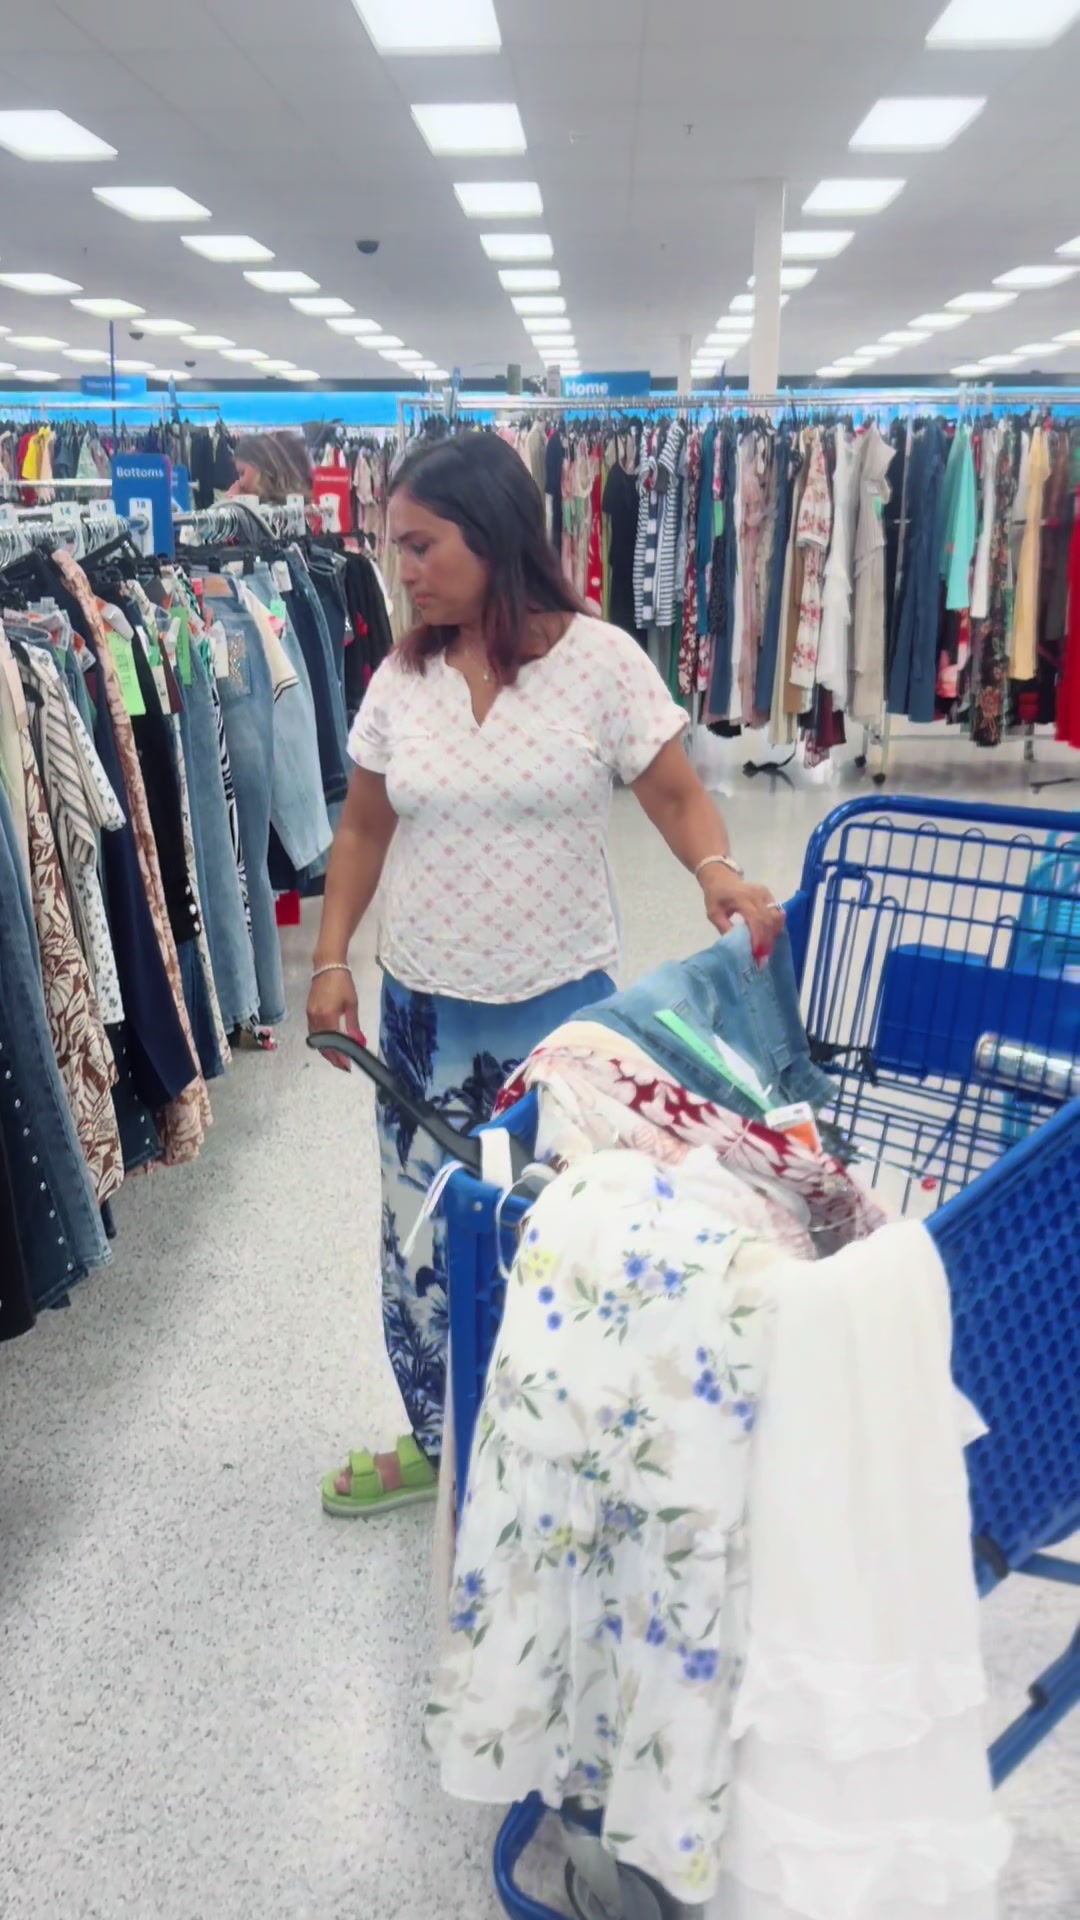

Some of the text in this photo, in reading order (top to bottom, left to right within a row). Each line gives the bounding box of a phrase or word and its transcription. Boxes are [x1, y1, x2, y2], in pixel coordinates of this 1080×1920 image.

[565, 381, 609, 397] Home
[116, 466, 164, 479] Bottoms
[60, 506, 71, 516] 14
